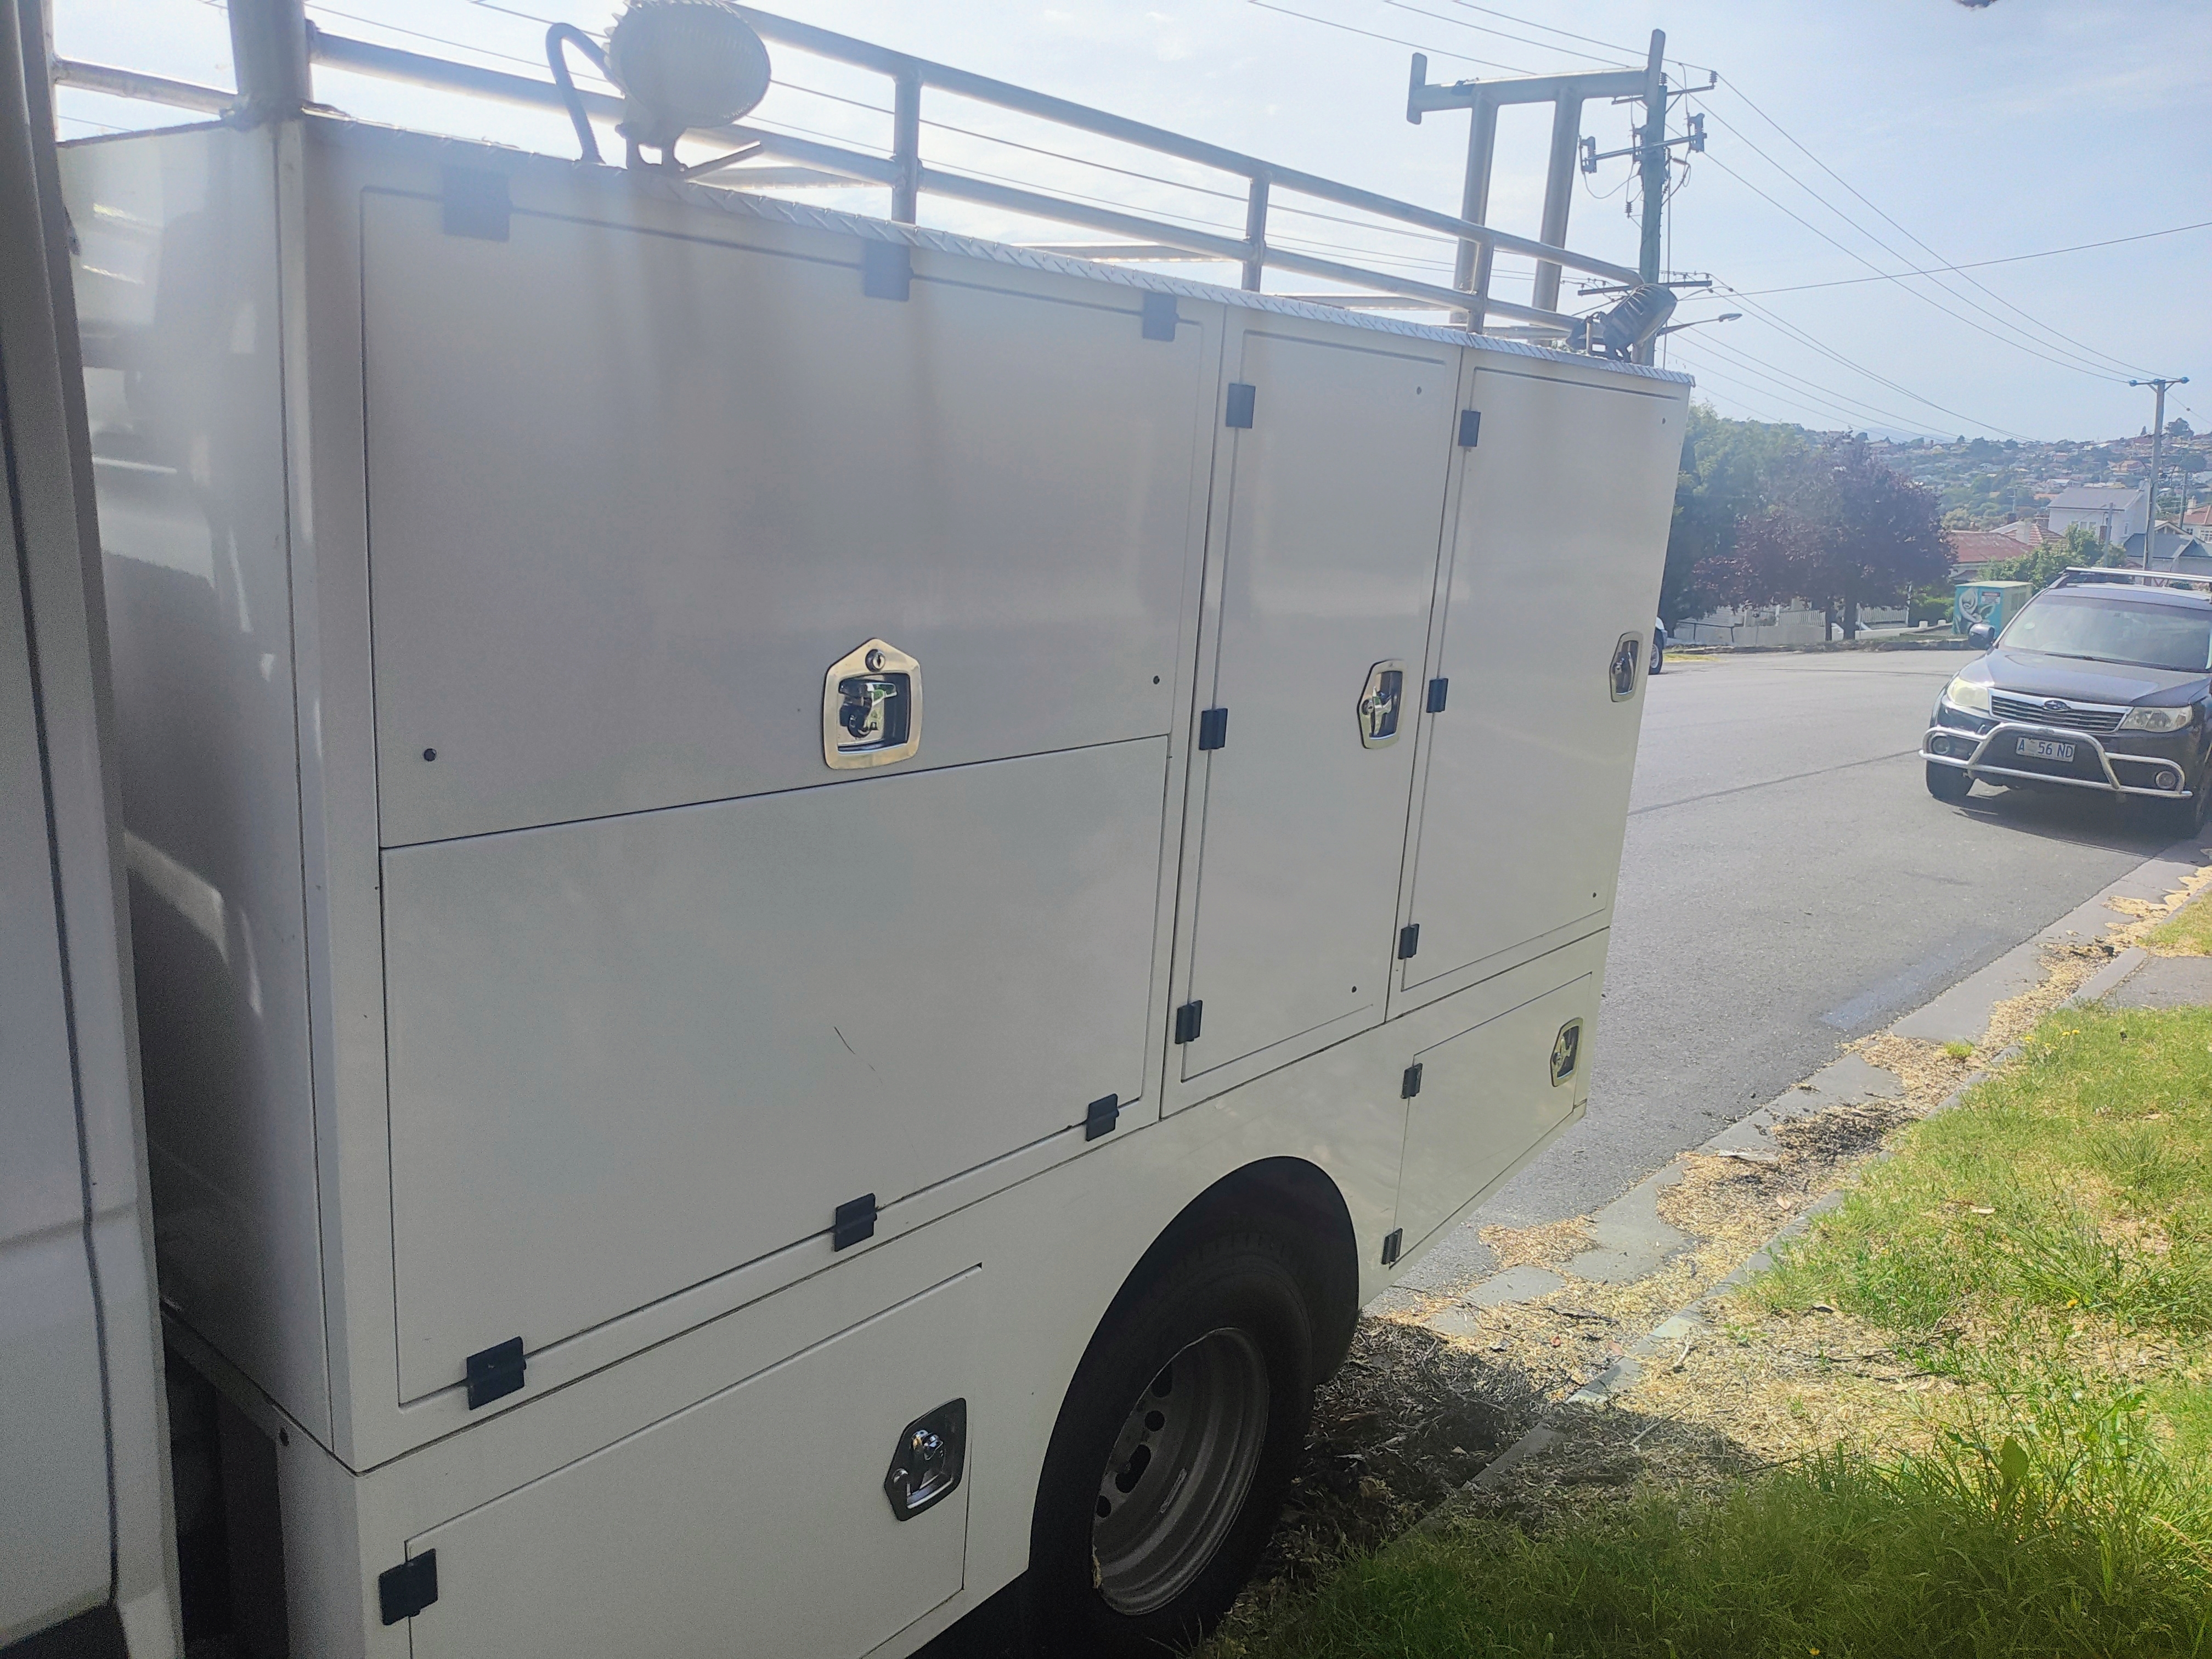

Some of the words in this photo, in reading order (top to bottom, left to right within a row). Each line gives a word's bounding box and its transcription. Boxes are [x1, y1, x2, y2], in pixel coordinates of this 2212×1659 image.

[2017, 739, 2025, 752] A
[2038, 742, 2053, 755] 56
[2057, 744, 2074, 758] ND
